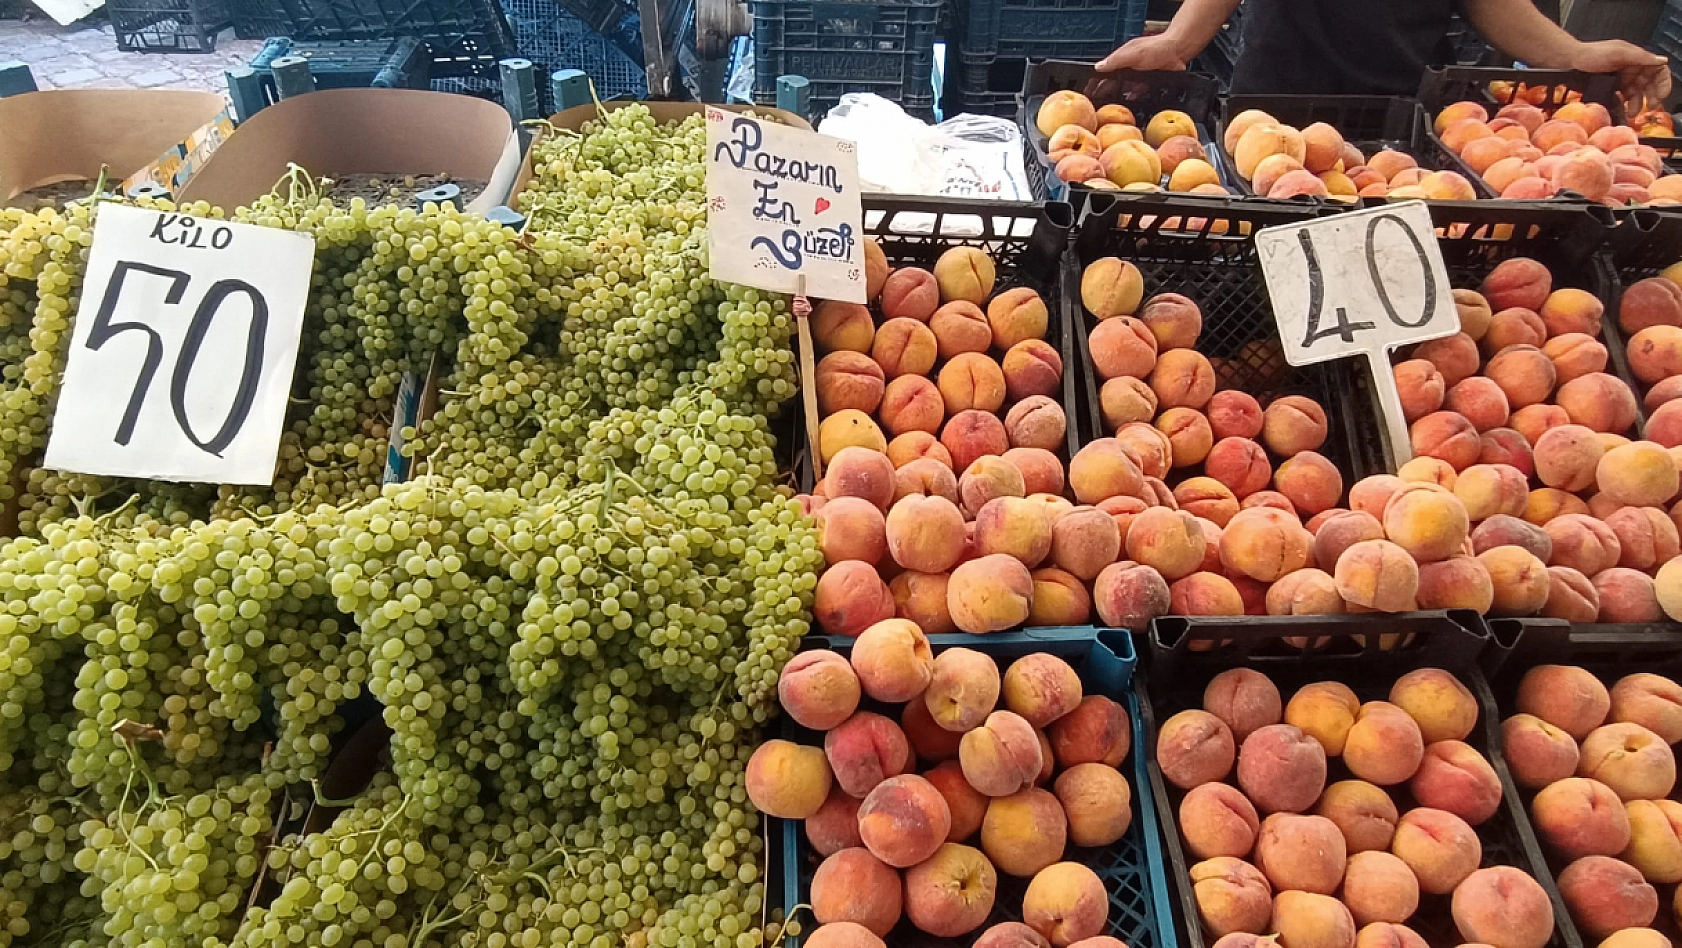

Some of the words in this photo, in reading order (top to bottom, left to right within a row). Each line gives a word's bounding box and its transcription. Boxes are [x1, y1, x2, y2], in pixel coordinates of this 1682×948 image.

[753, 179, 801, 224] En
[1298, 214, 1436, 347] 40
[85, 260, 269, 459] 50
